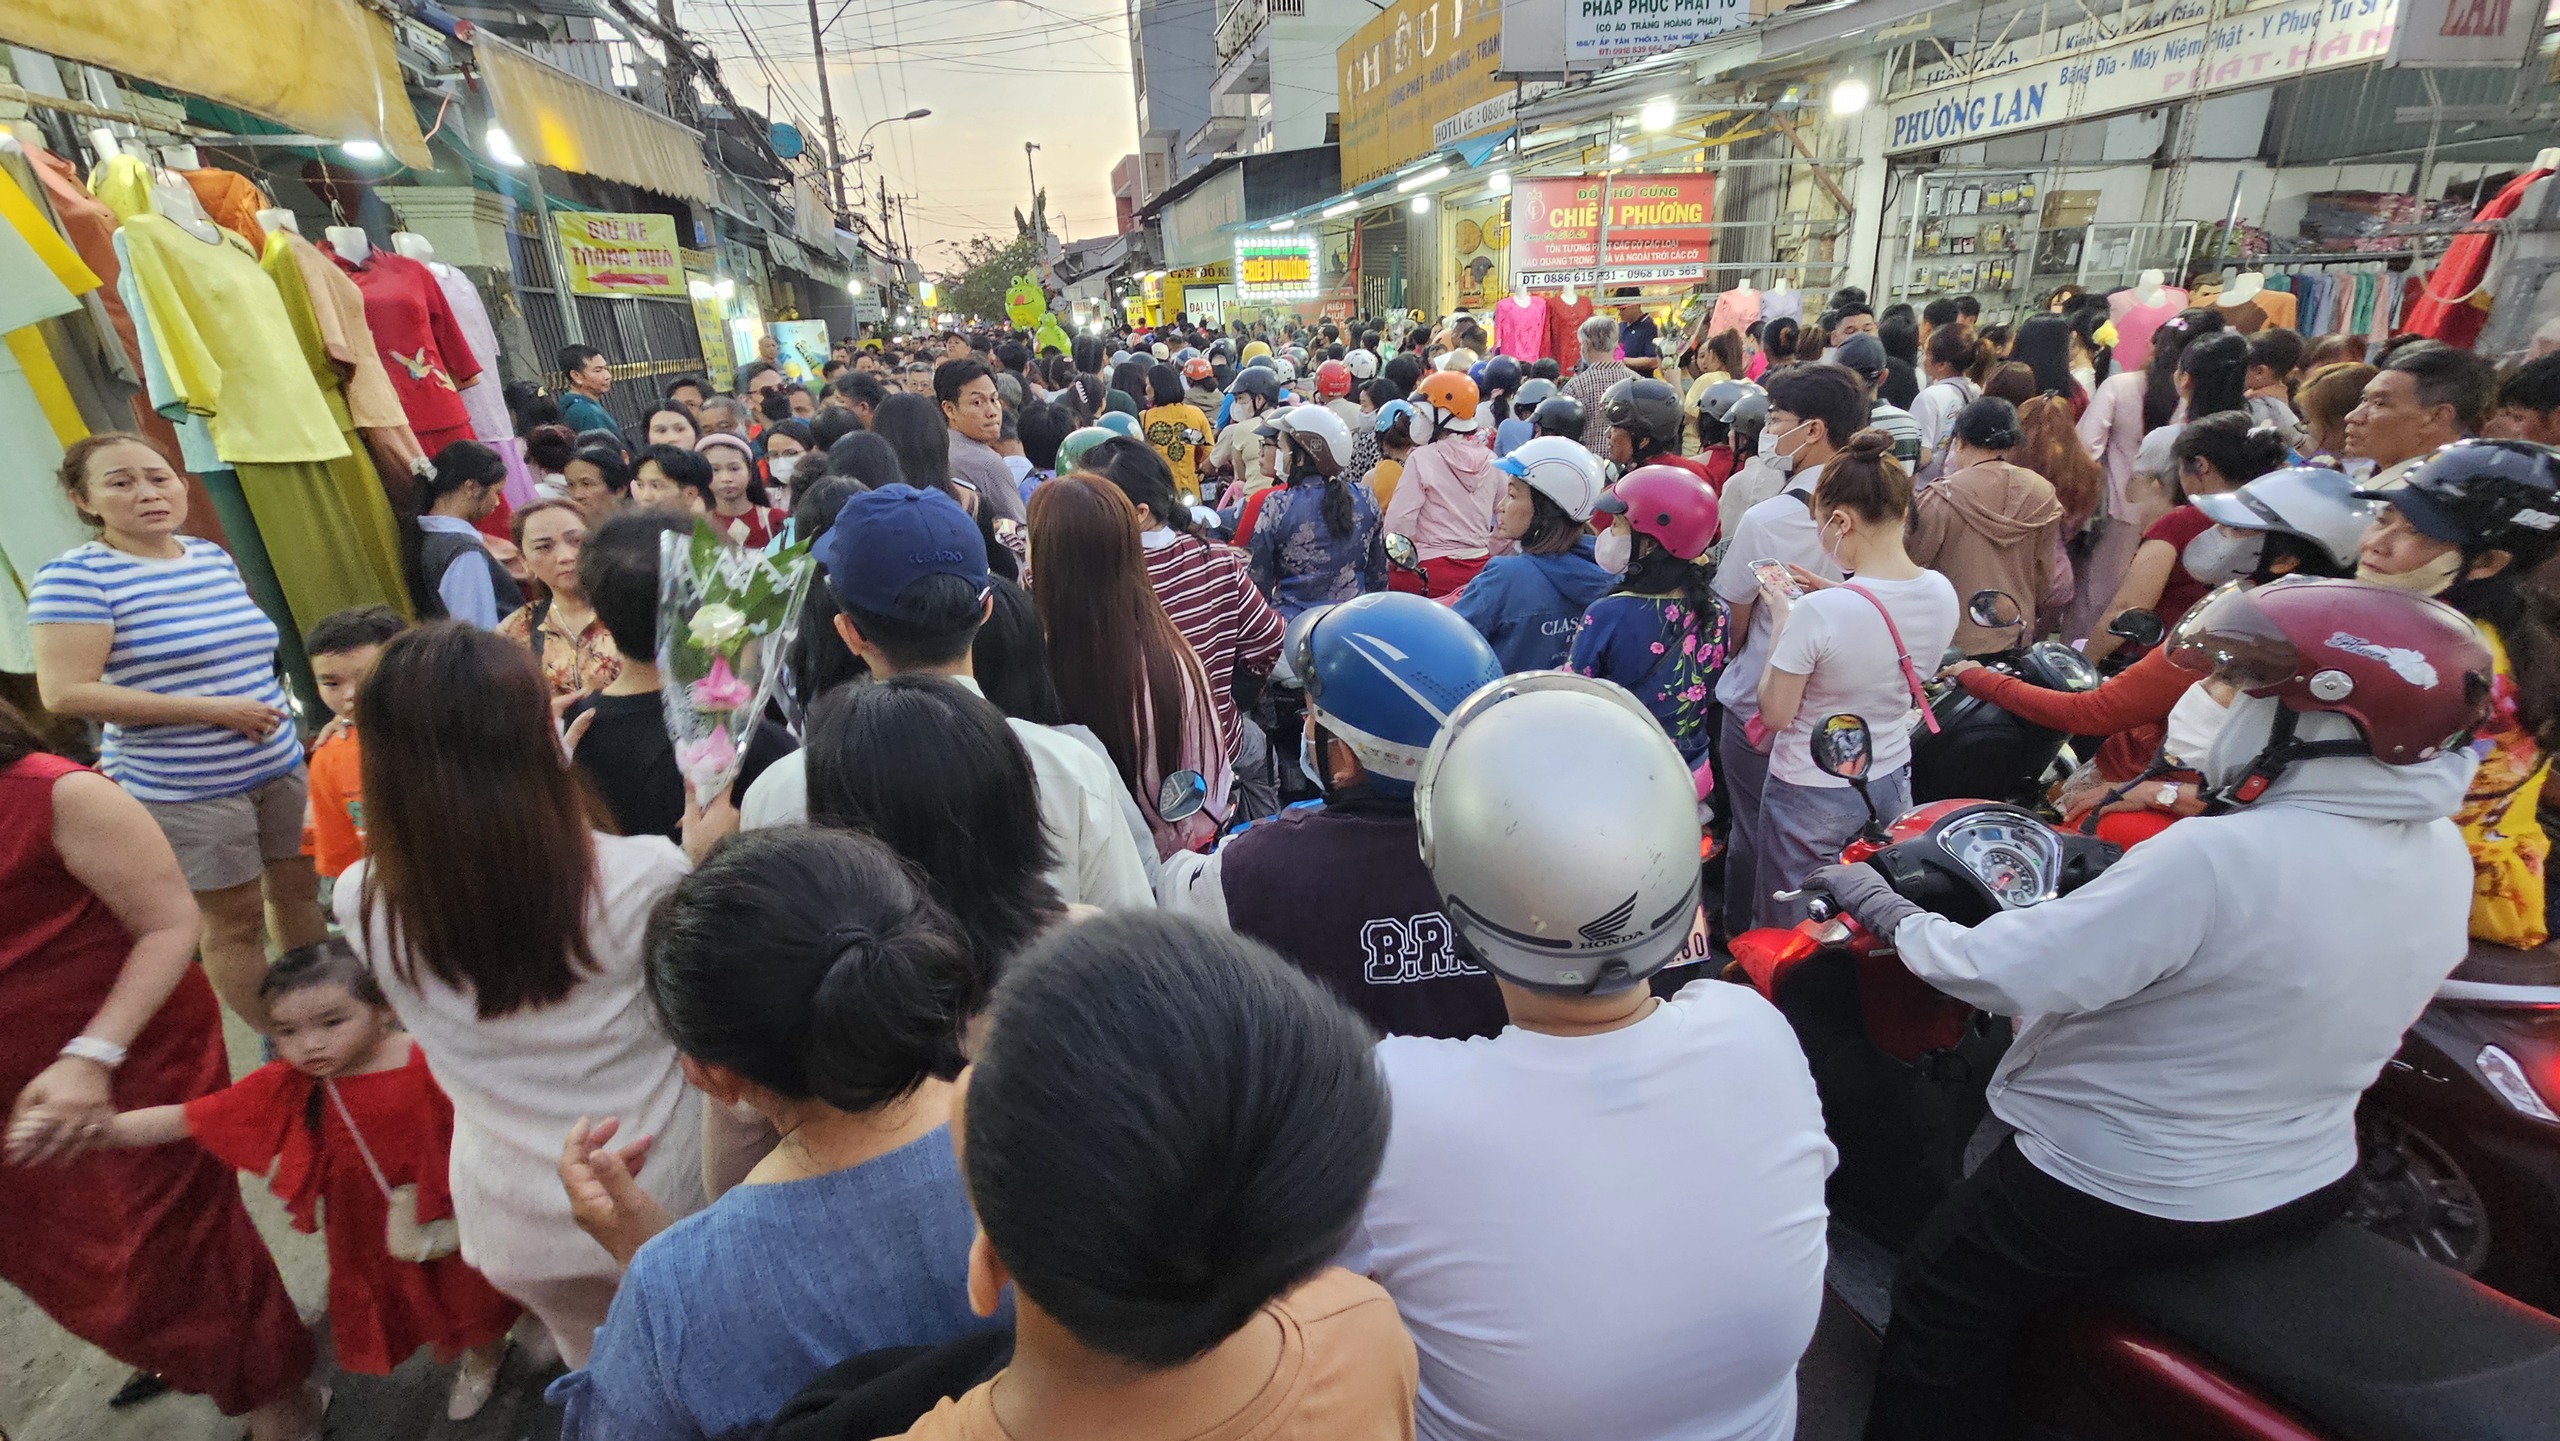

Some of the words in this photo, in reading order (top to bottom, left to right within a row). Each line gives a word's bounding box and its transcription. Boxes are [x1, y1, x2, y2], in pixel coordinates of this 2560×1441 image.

[2095, 56, 2117, 78] Đĩa
[2129, 45, 2158, 70] Máy
[2163, 37, 2202, 64] Niệm
[1892, 96, 1985, 147] PHƯƠNG
[1989, 82, 2048, 128] LAN
[1620, 201, 1703, 225] PHƯƠNG
[1543, 272, 1571, 284] 0886
[1574, 270, 1594, 282] 615
[1541, 617, 1579, 636] CLAS
[1579, 930, 1645, 949] HONDA
